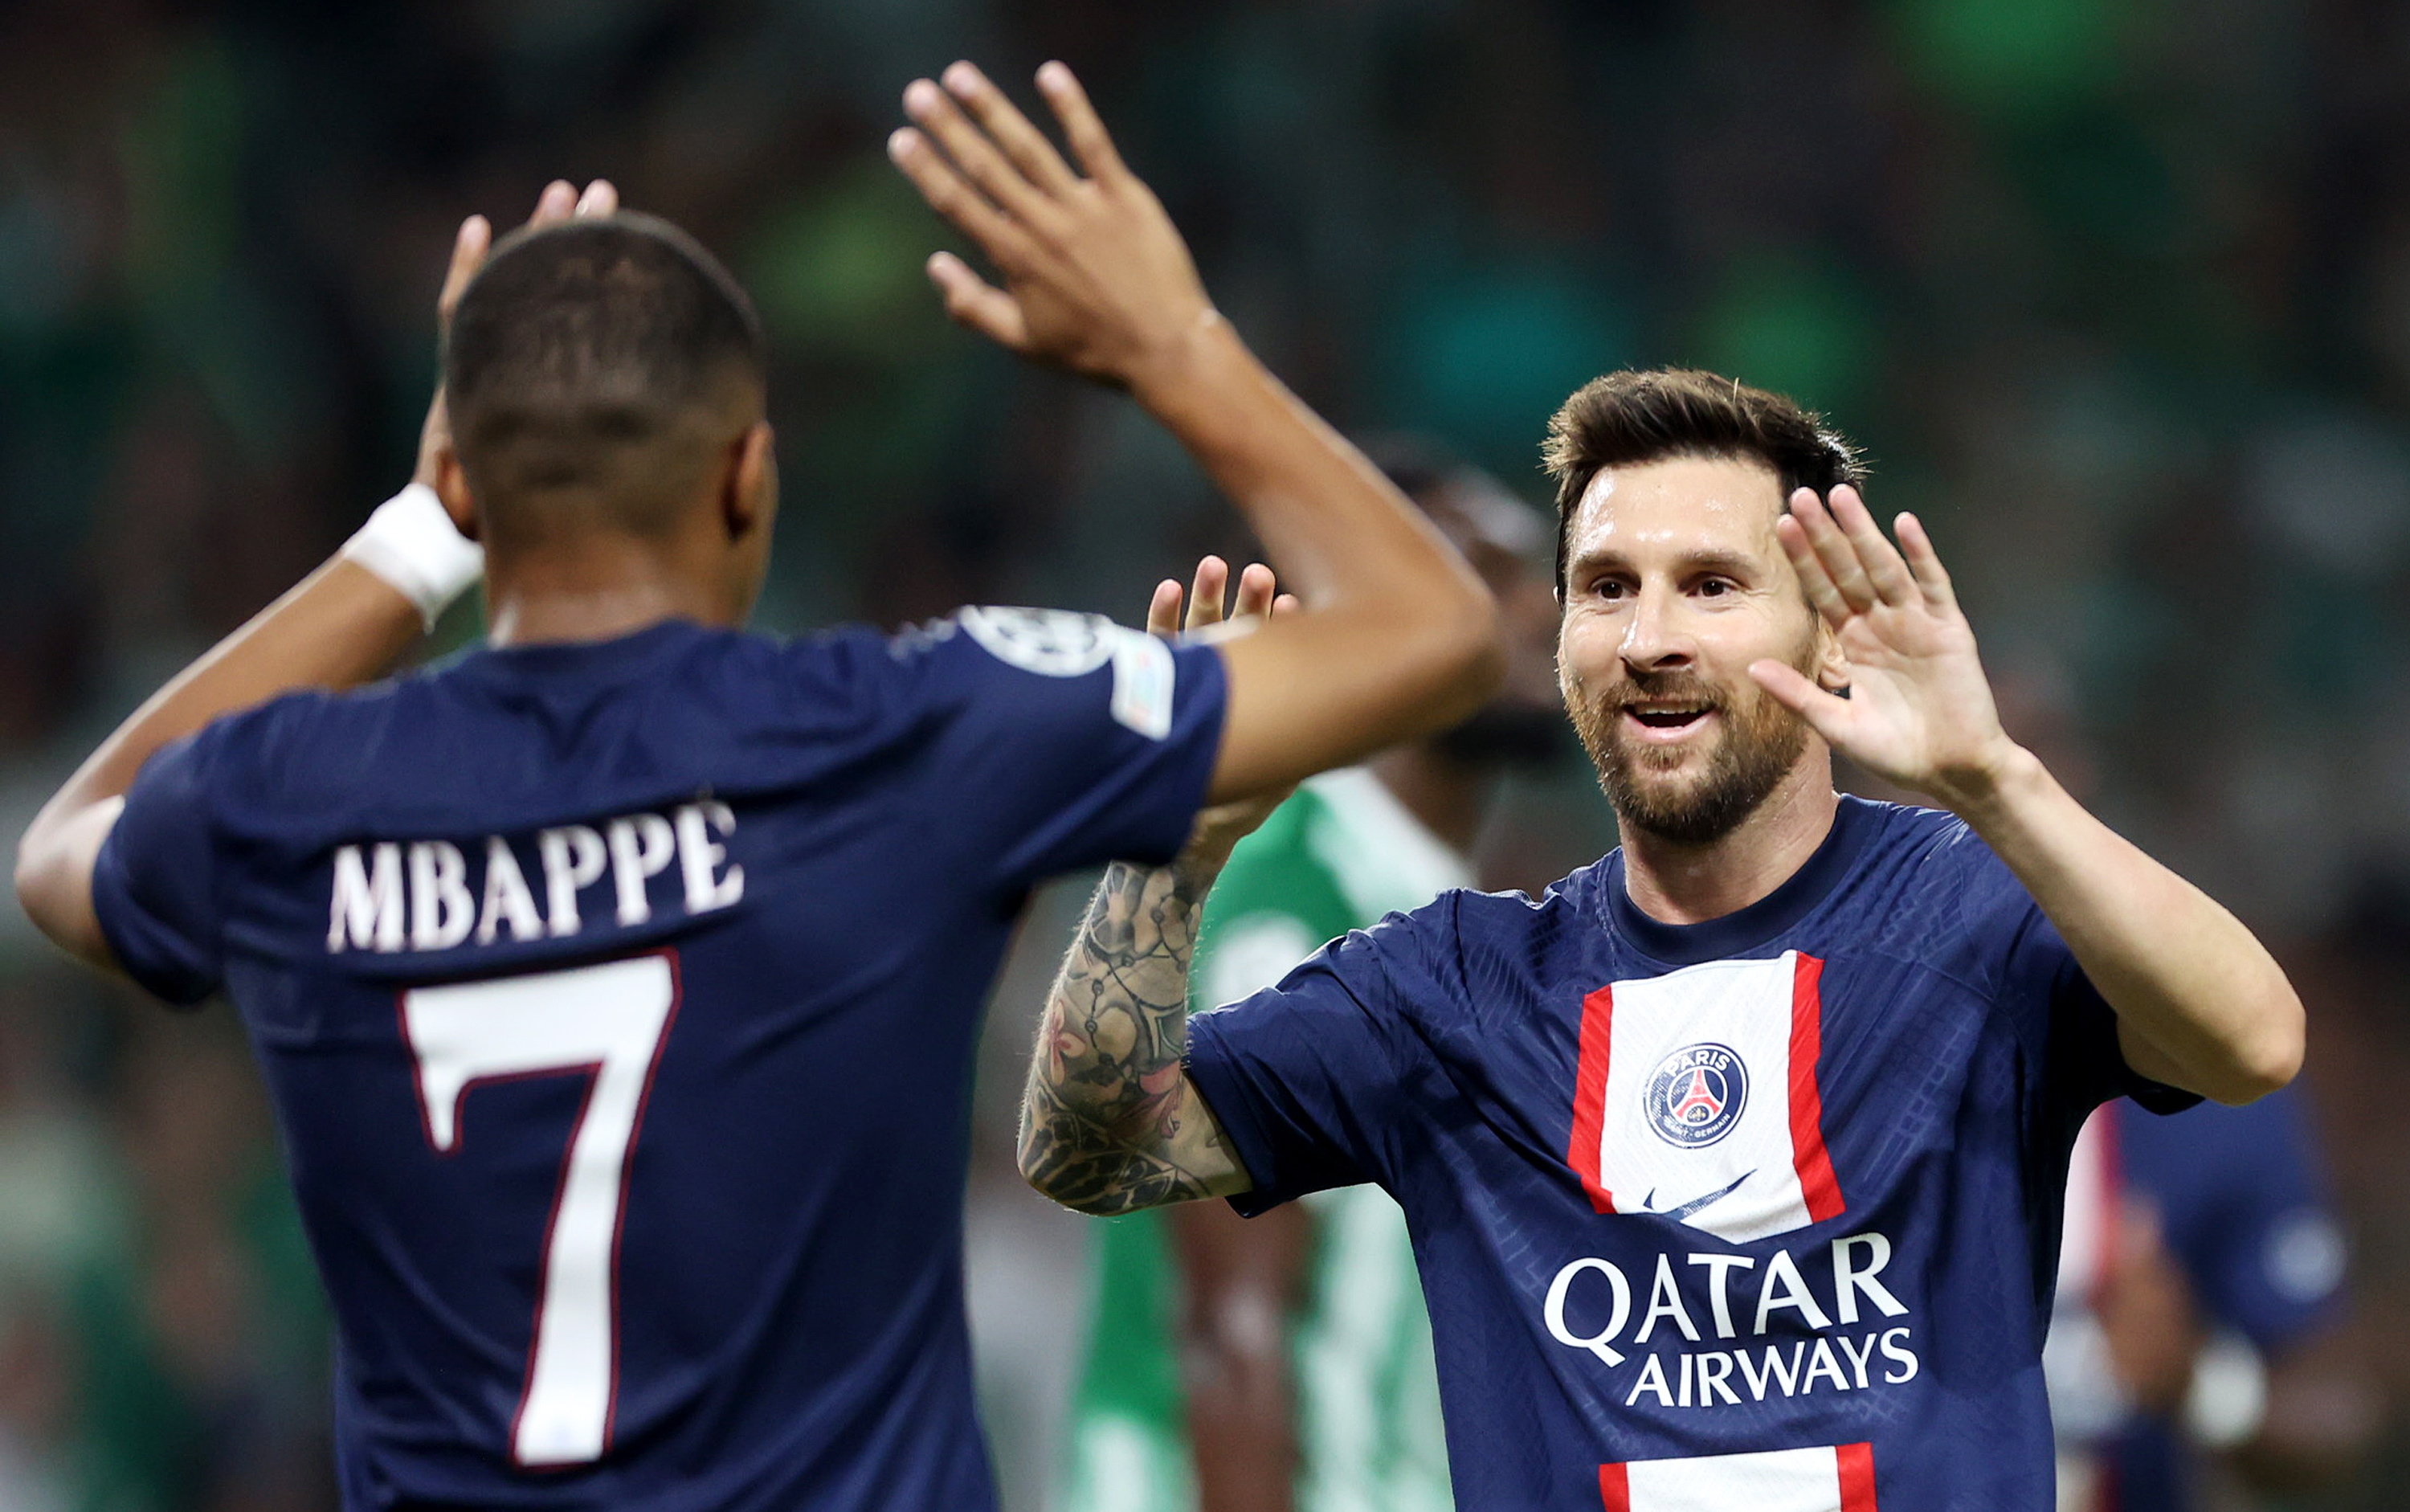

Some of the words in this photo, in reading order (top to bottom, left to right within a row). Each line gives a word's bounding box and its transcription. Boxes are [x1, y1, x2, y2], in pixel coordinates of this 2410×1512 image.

[1664, 1050, 1730, 1077] PARIS
[395, 946, 683, 1471] 7
[1544, 1232, 1910, 1368] QATAR
[1625, 1327, 1919, 1408] AIRWAYS
